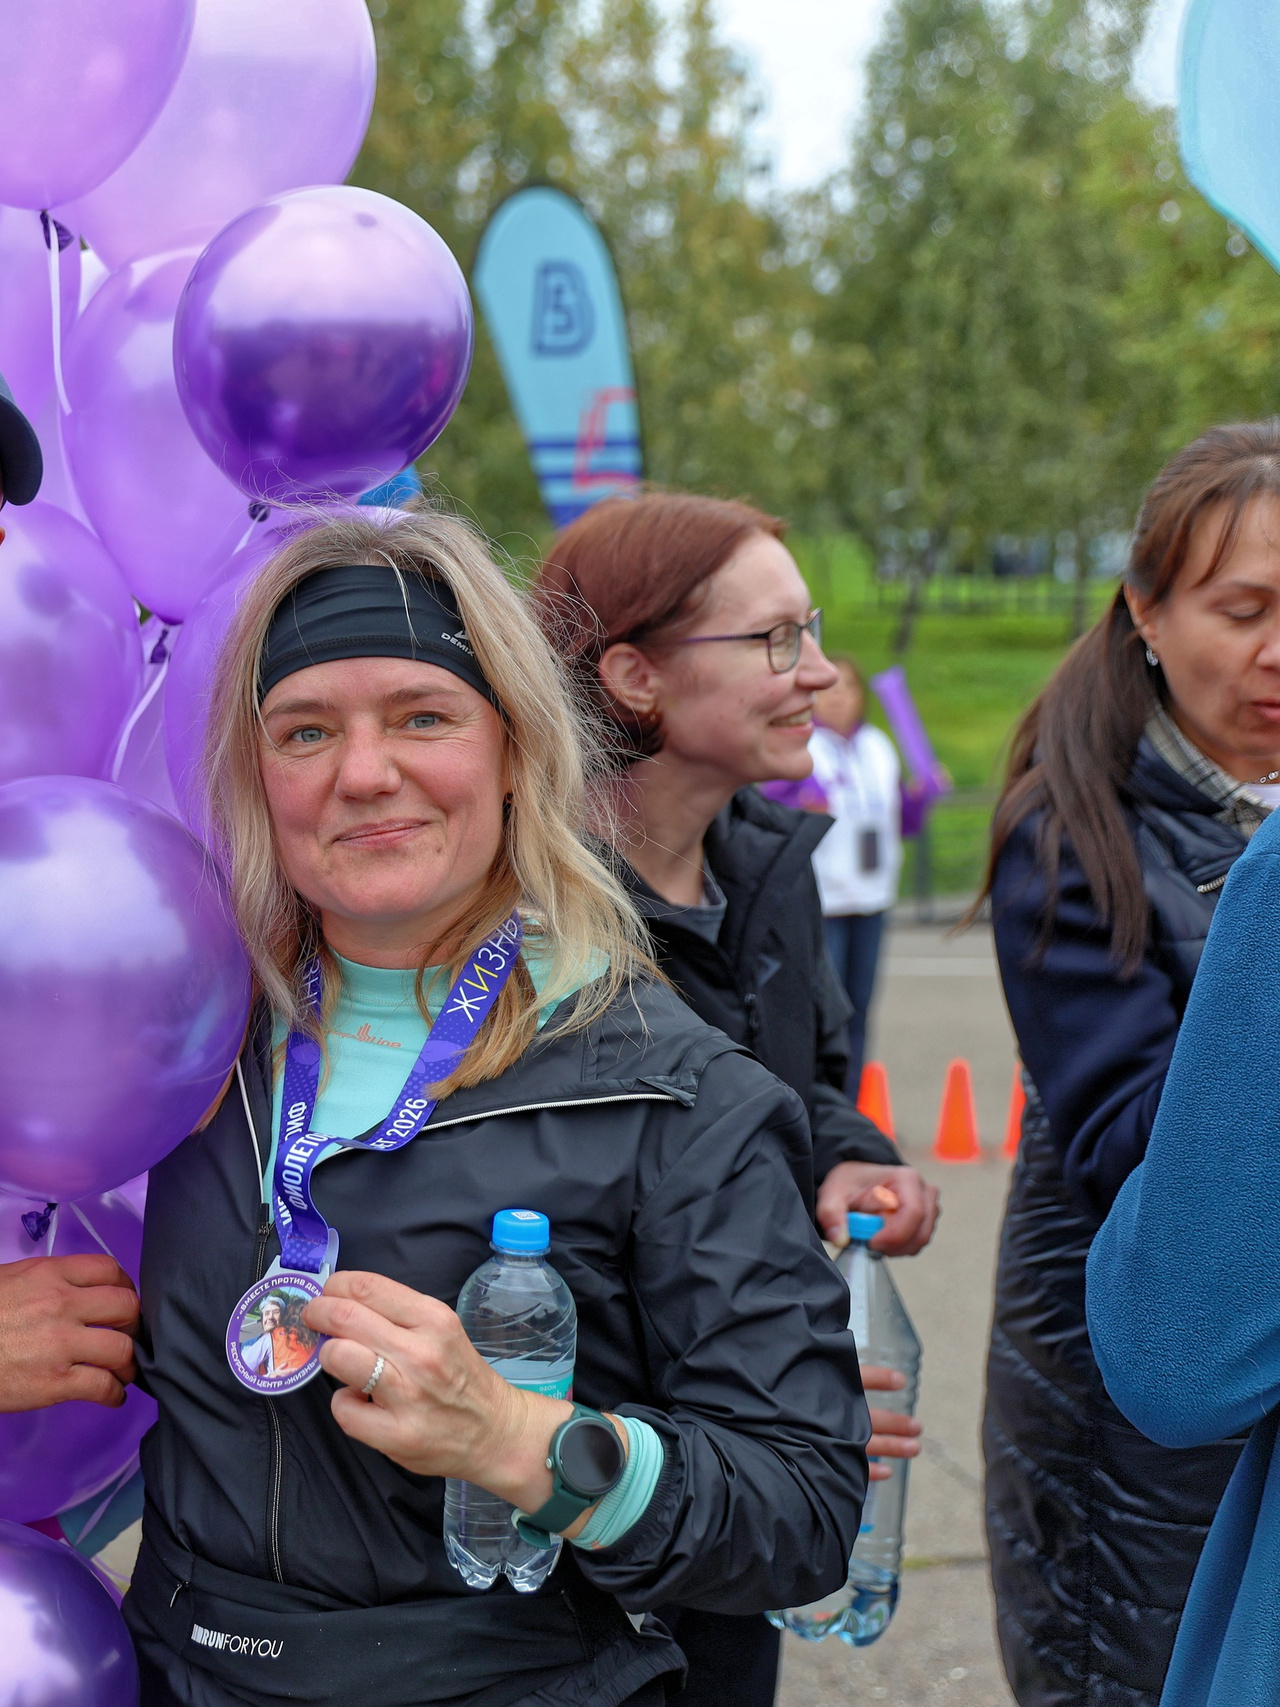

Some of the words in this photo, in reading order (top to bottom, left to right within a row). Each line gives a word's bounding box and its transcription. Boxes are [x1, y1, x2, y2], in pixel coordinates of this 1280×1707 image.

[441, 632, 474, 657] DEMIX
[446, 918, 518, 1023] ЖИЗНЬ
[385, 1098, 428, 1138] 2026
[271, 1276, 305, 1289] ПРОТИВ
[230, 1341, 257, 1385] РЕСУРСНЫЙ
[256, 1379, 283, 1389] ЦЕНТР
